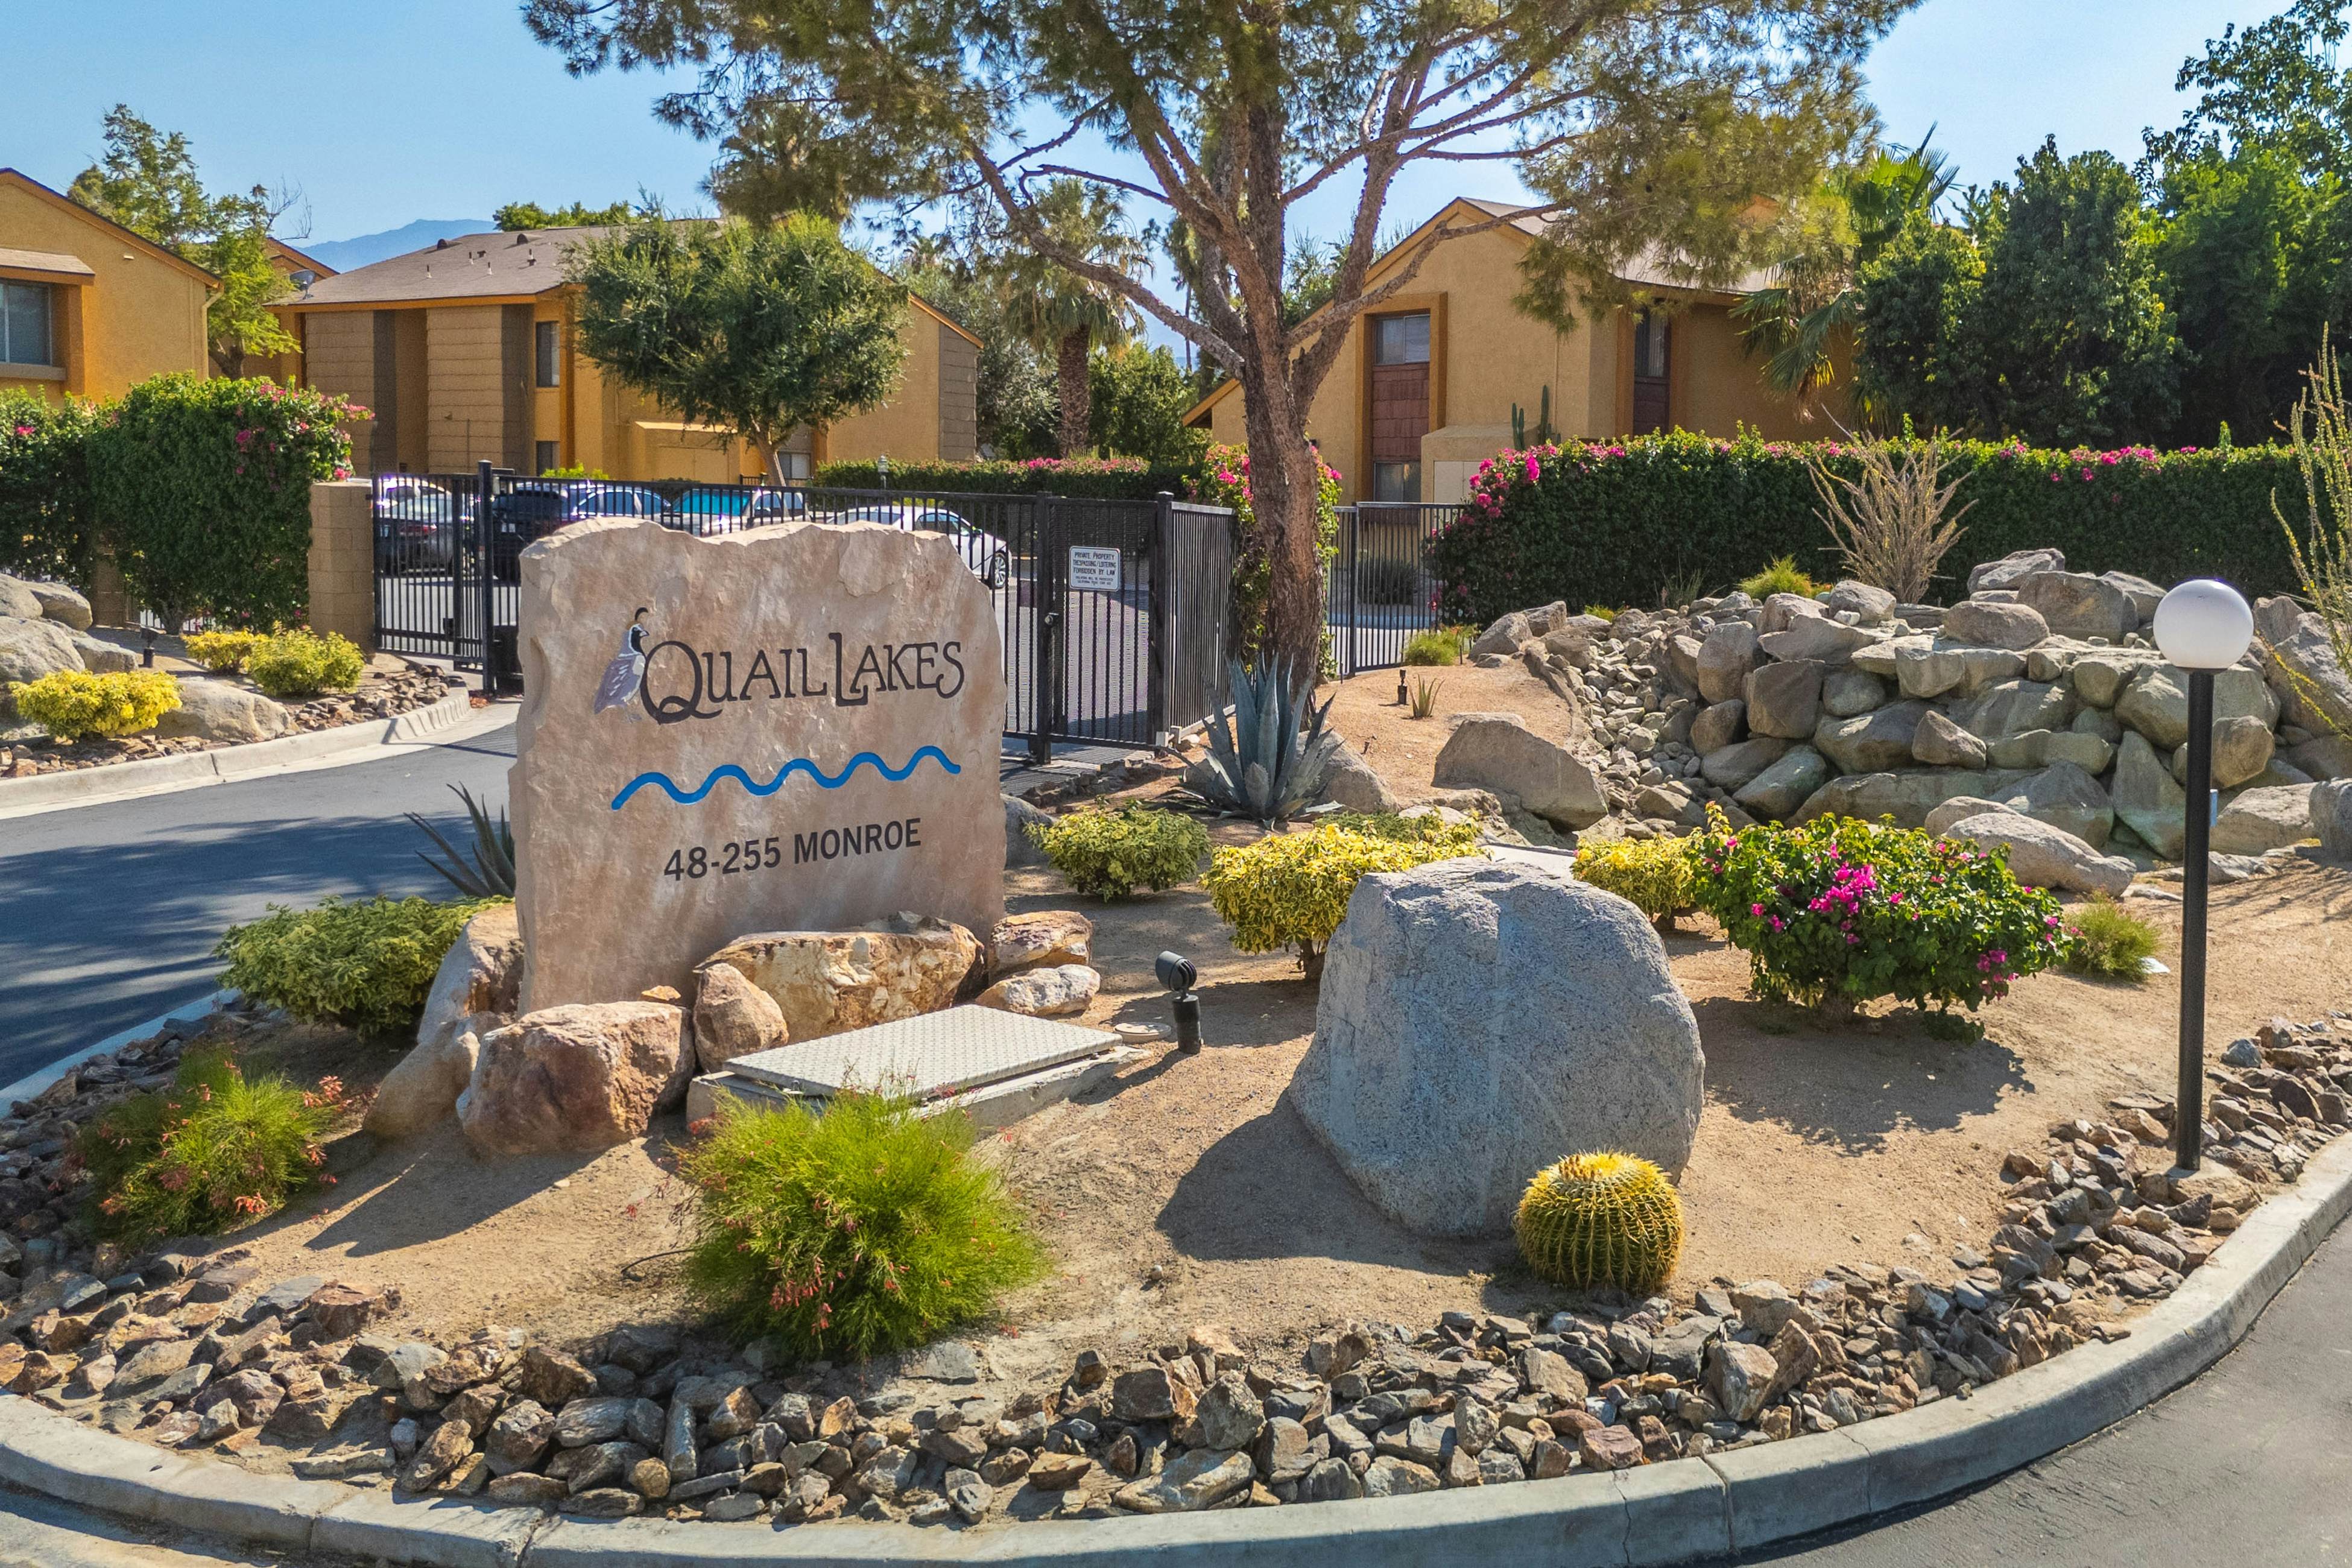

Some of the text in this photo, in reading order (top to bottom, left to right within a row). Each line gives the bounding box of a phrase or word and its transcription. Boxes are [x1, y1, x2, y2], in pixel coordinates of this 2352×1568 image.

[1093, 551, 1114, 560] PROPERTY
[640, 632, 964, 725] QUAIL LAKES
[664, 818, 922, 881] 48-255 MONROE
